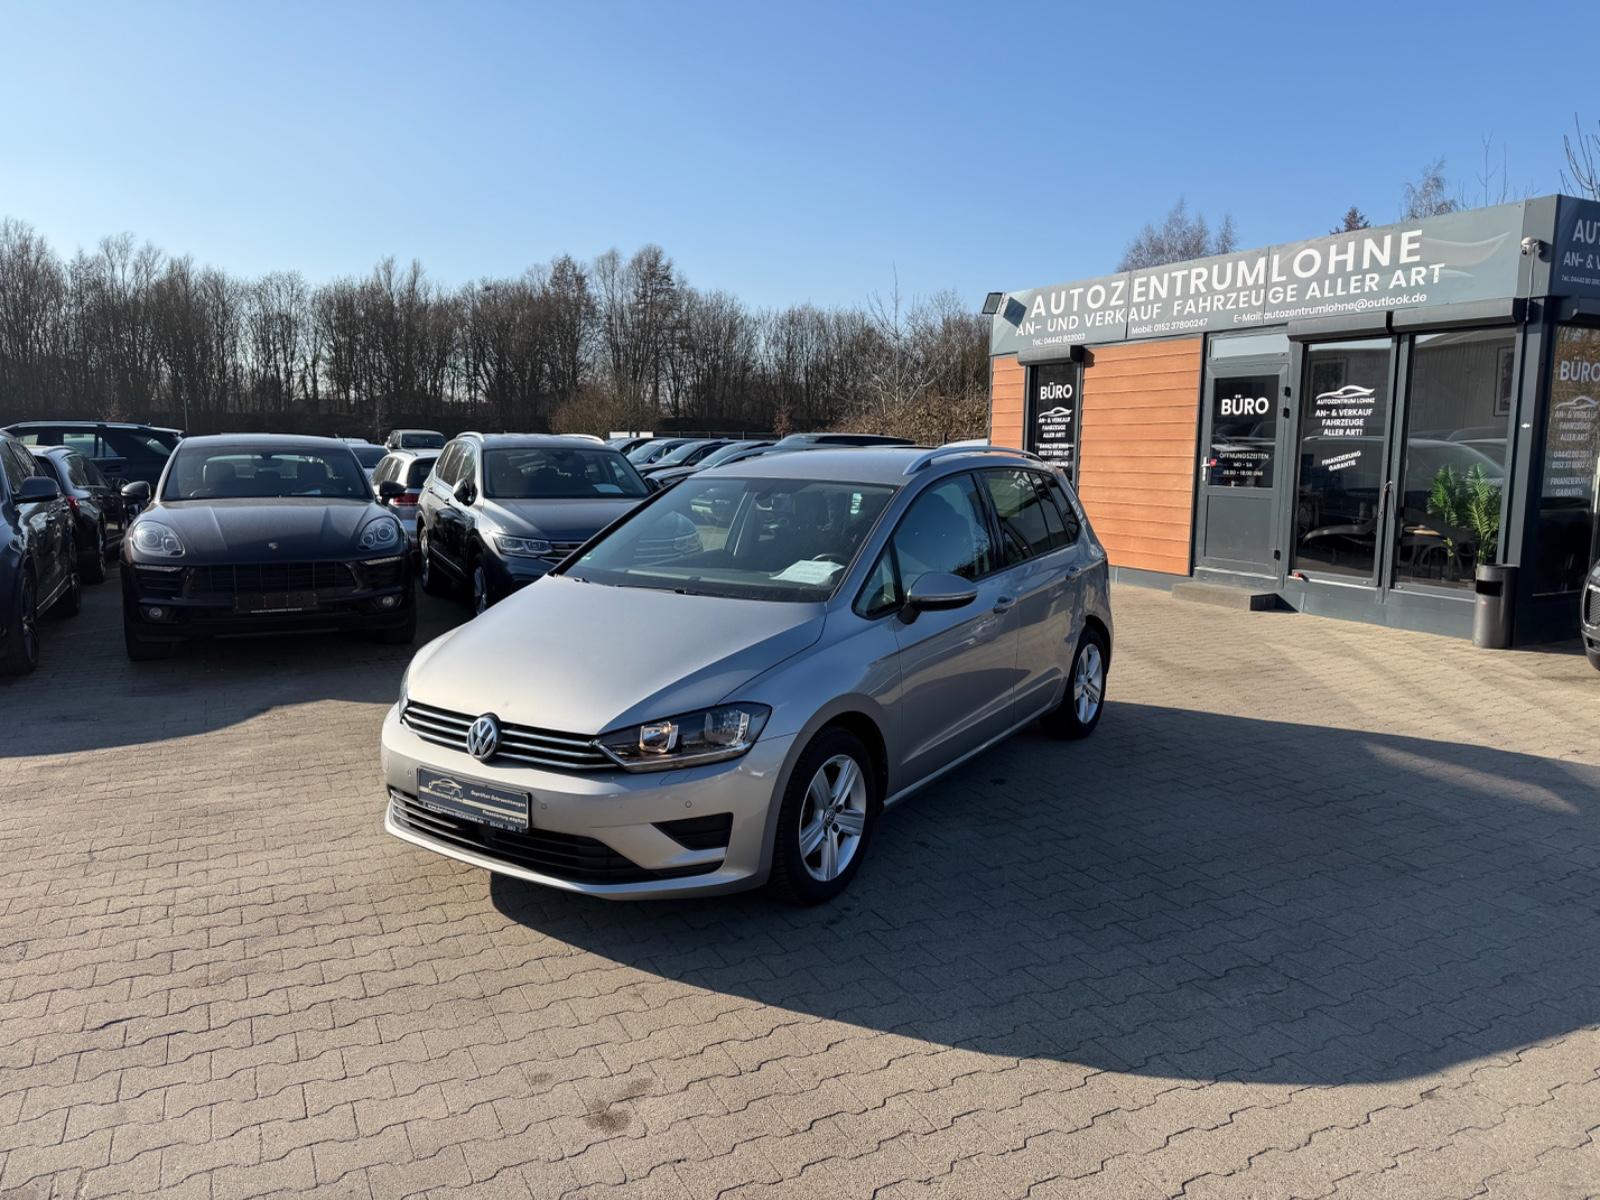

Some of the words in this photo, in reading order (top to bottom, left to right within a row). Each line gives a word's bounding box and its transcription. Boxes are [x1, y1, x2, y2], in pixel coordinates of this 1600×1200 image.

[1562, 250, 1584, 268] AN-
[1585, 253, 1594, 270] &
[1014, 319, 1042, 338] AN-
[1047, 315, 1081, 334] UND
[1084, 303, 1162, 328] VERKAUF
[1172, 284, 1298, 318] FAHRZEUGE
[1305, 271, 1381, 301] ALLER
[1387, 262, 1447, 290] ART
[1233, 311, 1262, 323] E-Mail:
[1263, 292, 1427, 320] autozentrumlohne@outlook.de
[1131, 324, 1152, 335] Mobil:
[1153, 322, 1170, 333] 0152
[1560, 356, 1600, 382] BÜRO
[1040, 381, 1073, 400] BÜRO
[1221, 393, 1270, 415] BÜRO
[1315, 409, 1330, 417] AN-
[1331, 408, 1338, 417] &
[1339, 408, 1374, 416] VERKAUF
[1322, 418, 1365, 426] FAHRZEUGE
[1323, 428, 1344, 436] ALLER
[1345, 428, 1363, 436] ART!
[1219, 451, 1269, 459] ÖFFNUNGSZEITEN
[1321, 450, 1361, 467] FINANZIERUNG
[1328, 459, 1357, 472] GARANTIE
